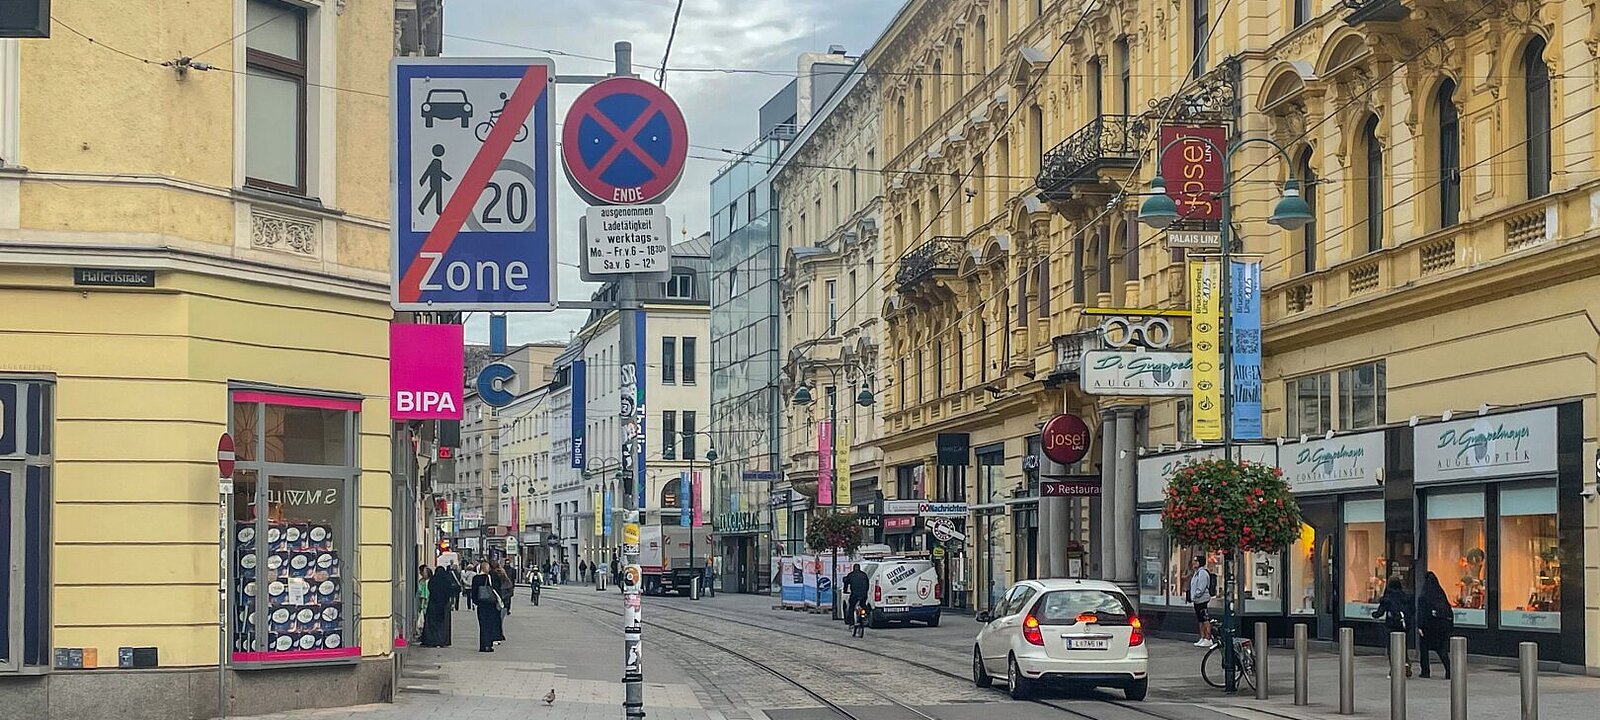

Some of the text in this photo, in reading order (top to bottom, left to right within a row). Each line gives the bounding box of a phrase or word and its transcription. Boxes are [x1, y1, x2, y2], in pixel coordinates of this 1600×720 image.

[613, 187, 644, 202] ENDE
[482, 182, 528, 224] 20
[601, 207, 653, 218] ausgenommen
[603, 220, 652, 232] Ladetätigkeit
[607, 233, 652, 244] werktags
[1169, 234, 1218, 244] PALAIS LINZ
[590, 248, 604, 257] Mo.
[624, 259, 630, 268] 6
[419, 252, 529, 291] Zone
[396, 391, 456, 413] BIPA
[1046, 430, 1087, 450] josef
[574, 437, 583, 465] Thalia
[1438, 451, 1530, 468] AUGENOPTIK
[1058, 484, 1102, 494] Restaura
